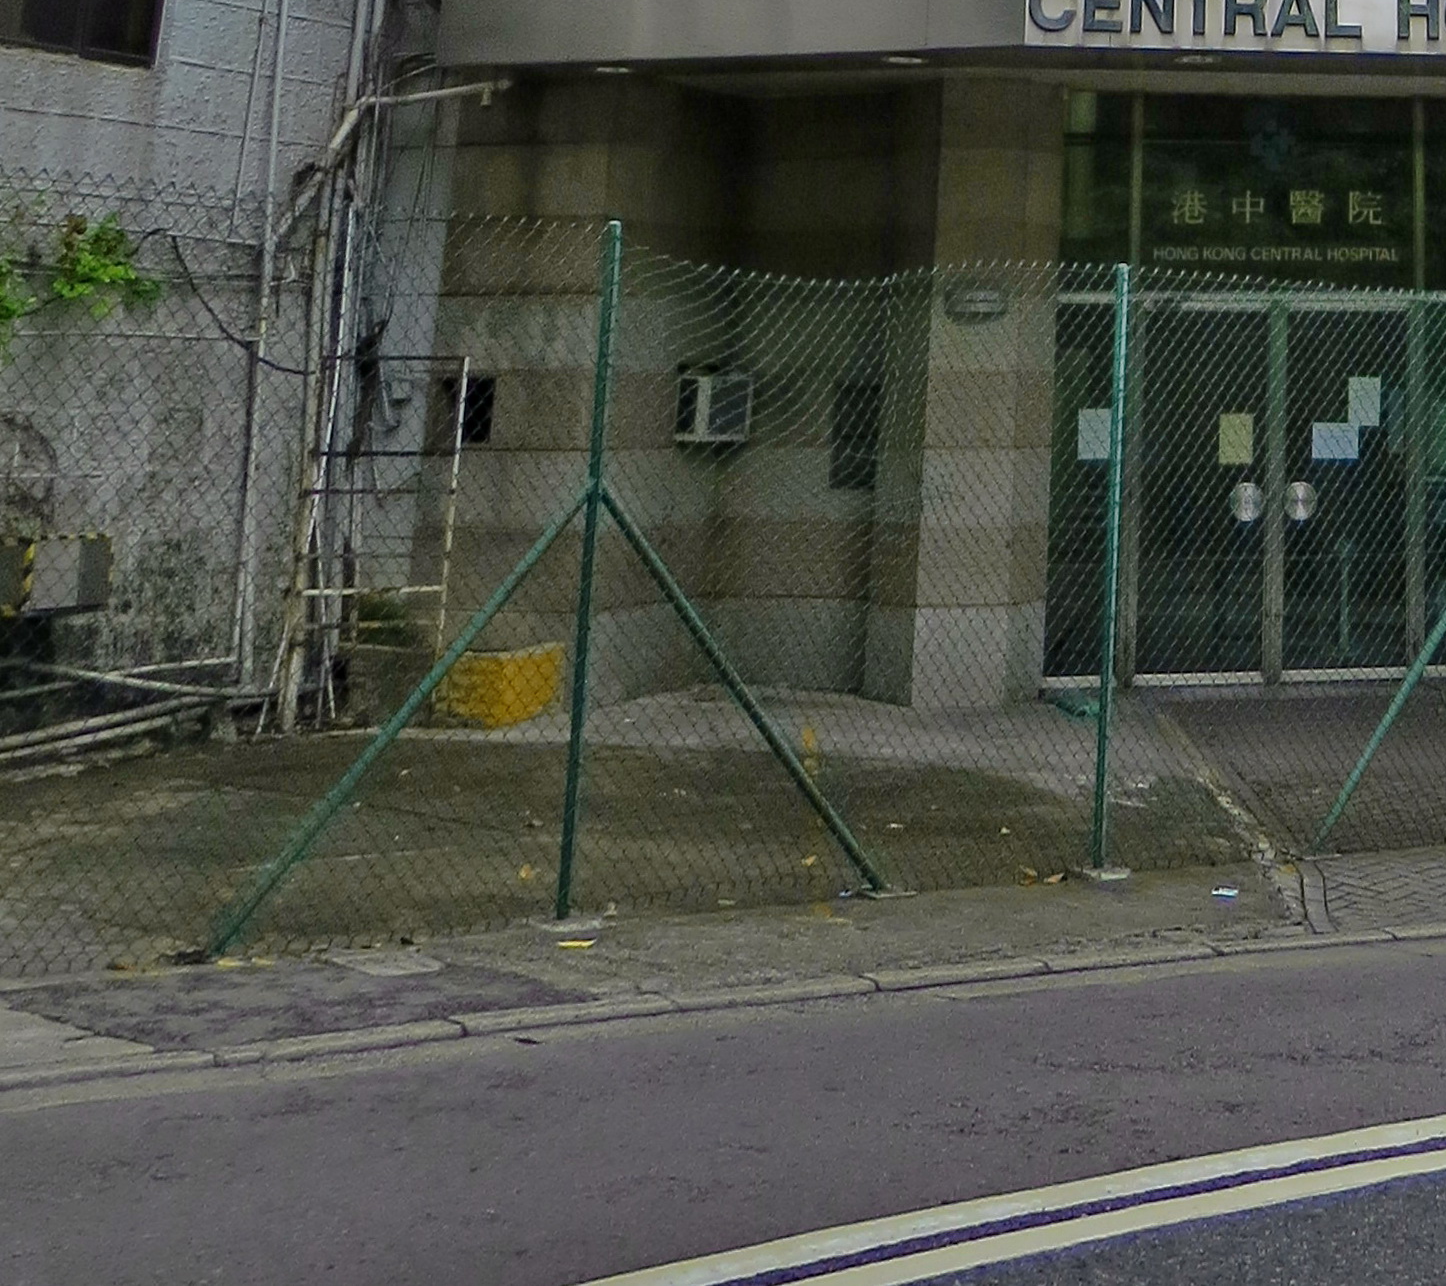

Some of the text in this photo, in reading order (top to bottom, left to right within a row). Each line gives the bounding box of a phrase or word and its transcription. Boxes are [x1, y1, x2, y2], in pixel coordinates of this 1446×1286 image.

[1172, 190, 1384, 225] 港中醫院
[1153, 246, 1399, 262] HONG KONG CENTRAL HOSPITAL
